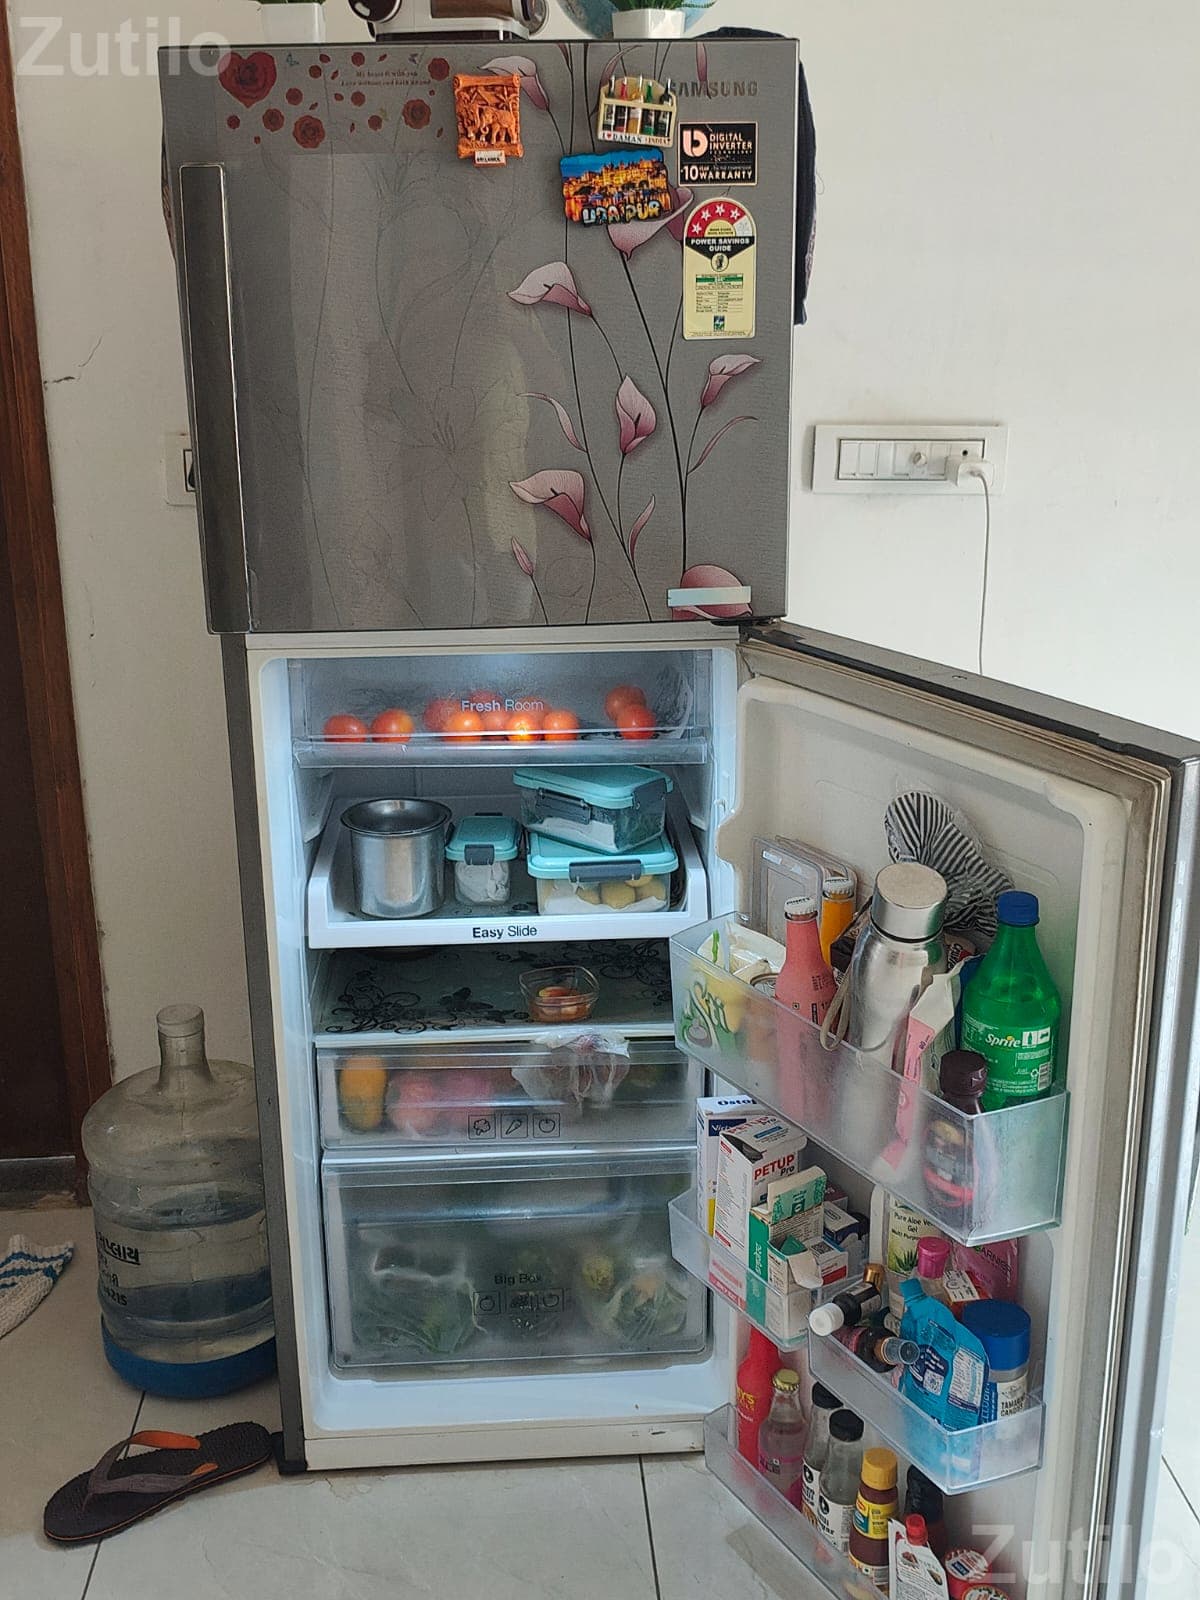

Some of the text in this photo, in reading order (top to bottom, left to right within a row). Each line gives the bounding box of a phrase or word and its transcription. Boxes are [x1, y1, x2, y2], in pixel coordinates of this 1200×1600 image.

[709, 133, 744, 142] DIGITAL
[709, 142, 753, 150] INVERTER
[683, 165, 699, 181] 10
[699, 171, 753, 180] WARRANTY
[461, 698, 544, 712] Fresh Room
[472, 925, 538, 940] Easy Slide
[985, 1033, 1021, 1048] Sprite
[753, 1154, 795, 1180] PETUP
[780, 1165, 795, 1177] Pro
[908, 1216, 921, 1225] Aloe
[494, 1272, 542, 1286] Big Box
